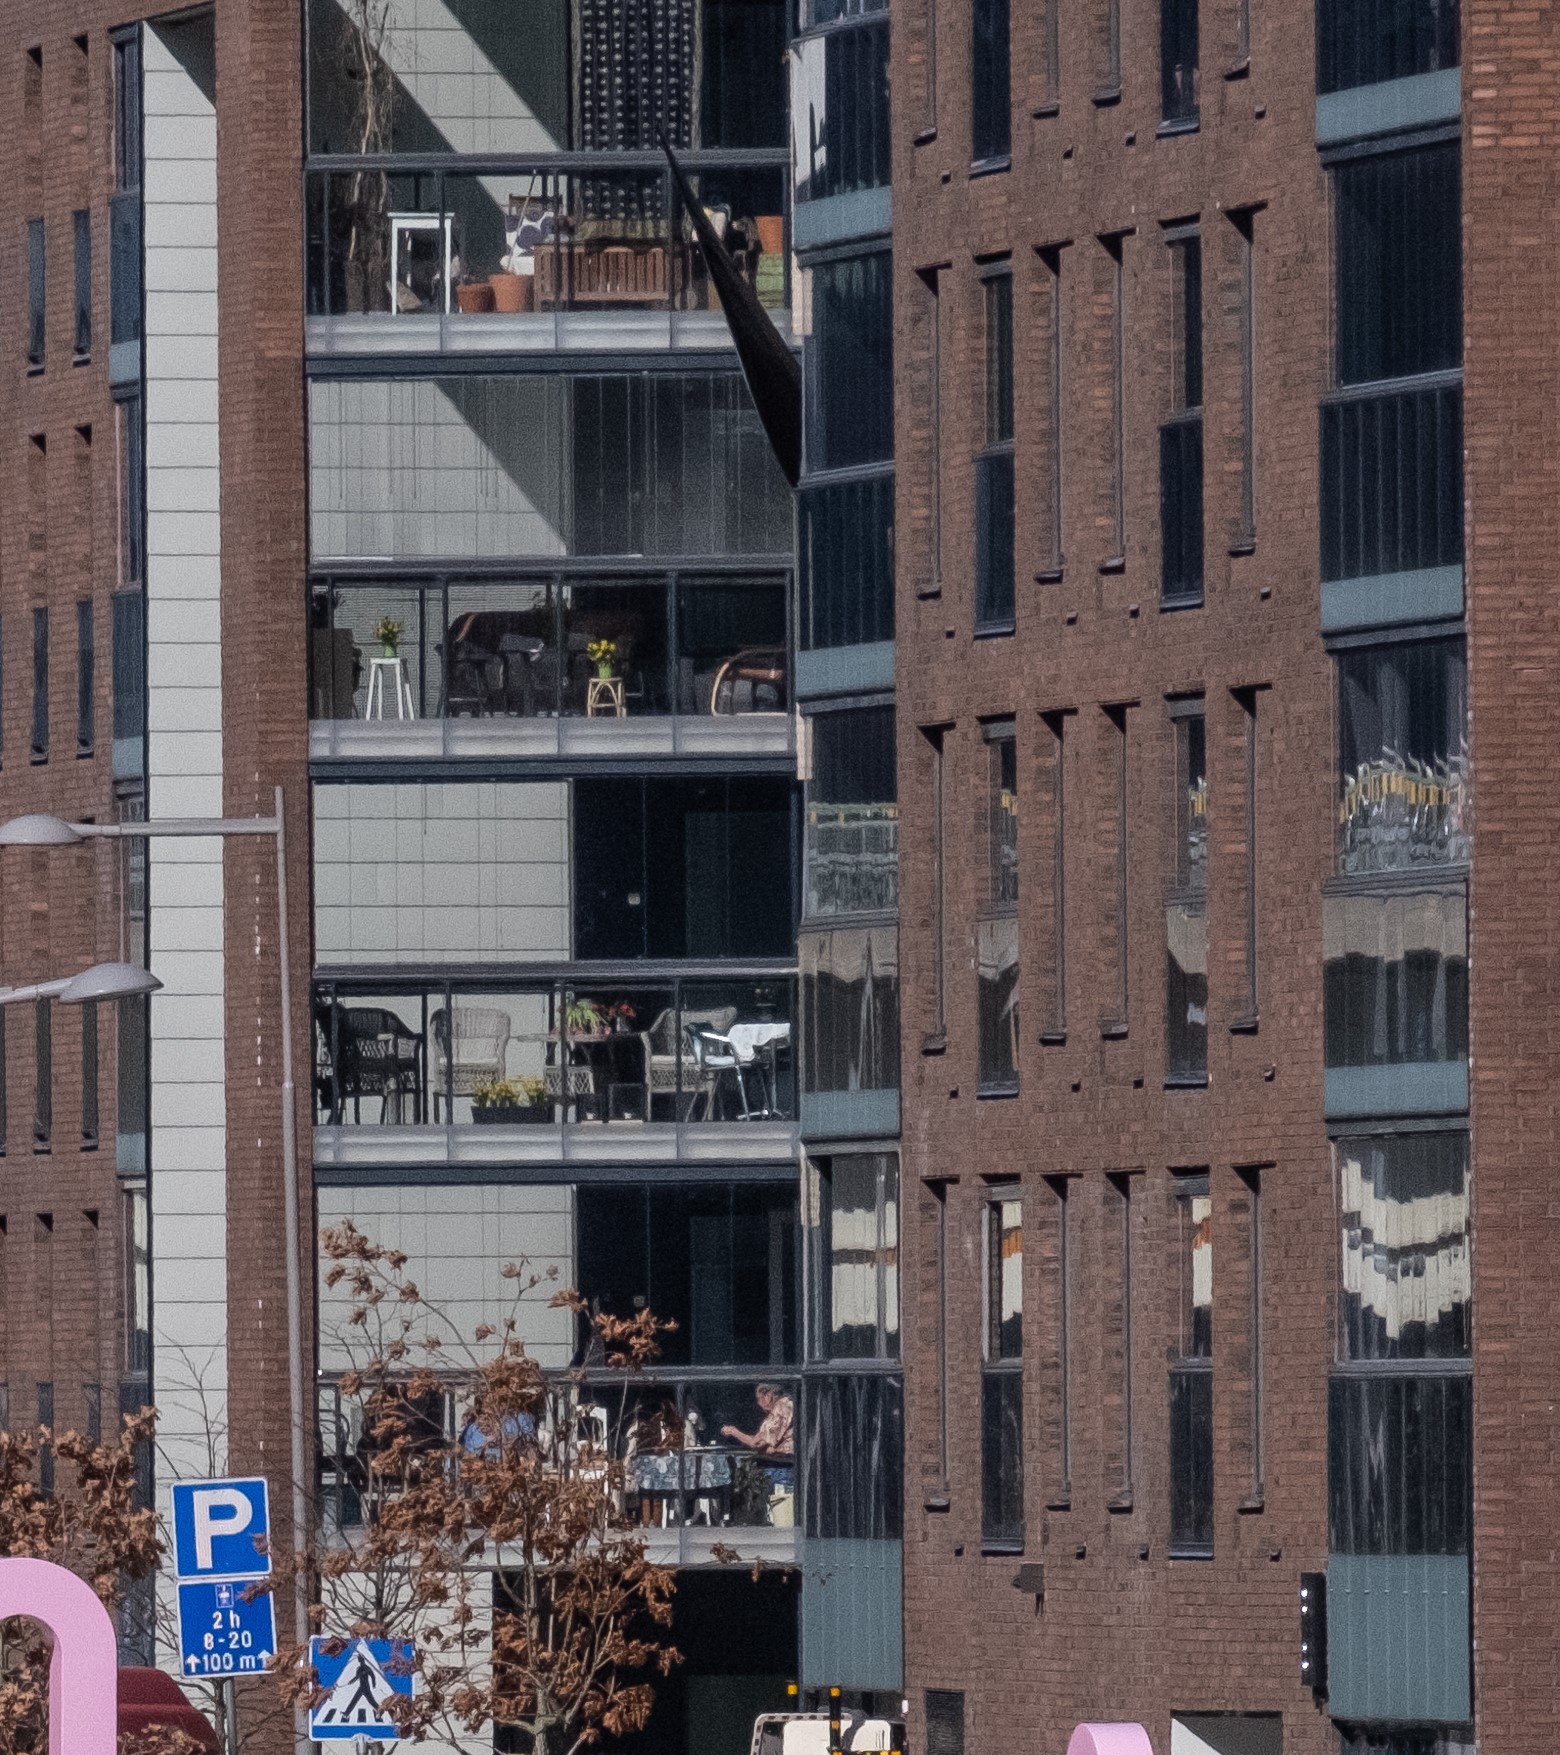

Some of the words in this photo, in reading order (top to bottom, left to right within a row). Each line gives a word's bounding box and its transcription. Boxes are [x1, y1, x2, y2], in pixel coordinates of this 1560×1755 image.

[193, 1488, 253, 1570] P
[212, 1612, 224, 1629] 2
[229, 1610, 241, 1628] h
[202, 1653, 234, 1672] 100
[239, 1654, 256, 1670] m
